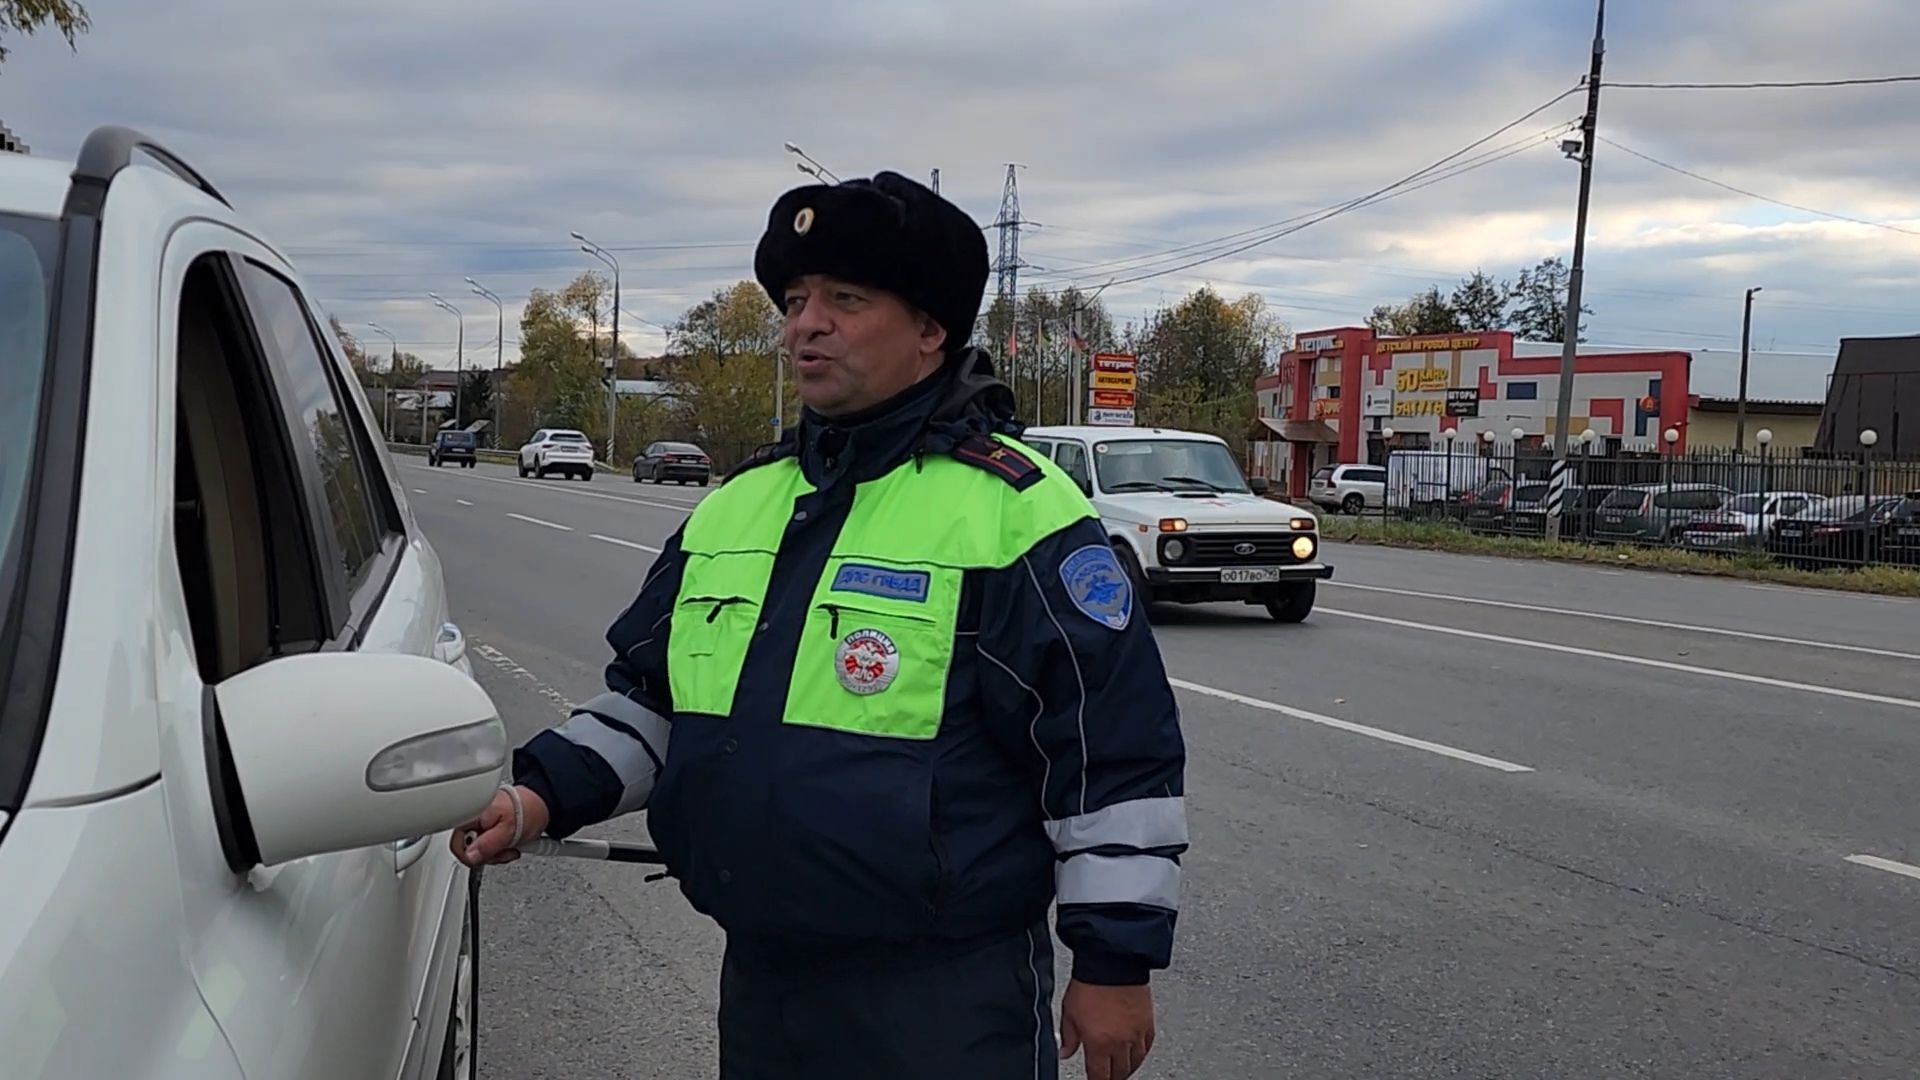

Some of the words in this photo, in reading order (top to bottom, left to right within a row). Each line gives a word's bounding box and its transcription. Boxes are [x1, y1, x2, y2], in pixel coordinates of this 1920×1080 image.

[1376, 340, 1412, 354] ДЕТСКИЙ
[1413, 338, 1450, 352] ИГРОВОЙ
[1450, 338, 1480, 351] ЦЕНТР
[1448, 390, 1478, 400] ШТОРЫ
[1395, 400, 1445, 416] БАТУТЫ
[838, 571, 869, 585] ДПС
[872, 574, 921, 594] ГИБДД
[847, 630, 895, 654] ПОЛИЦИЯ
